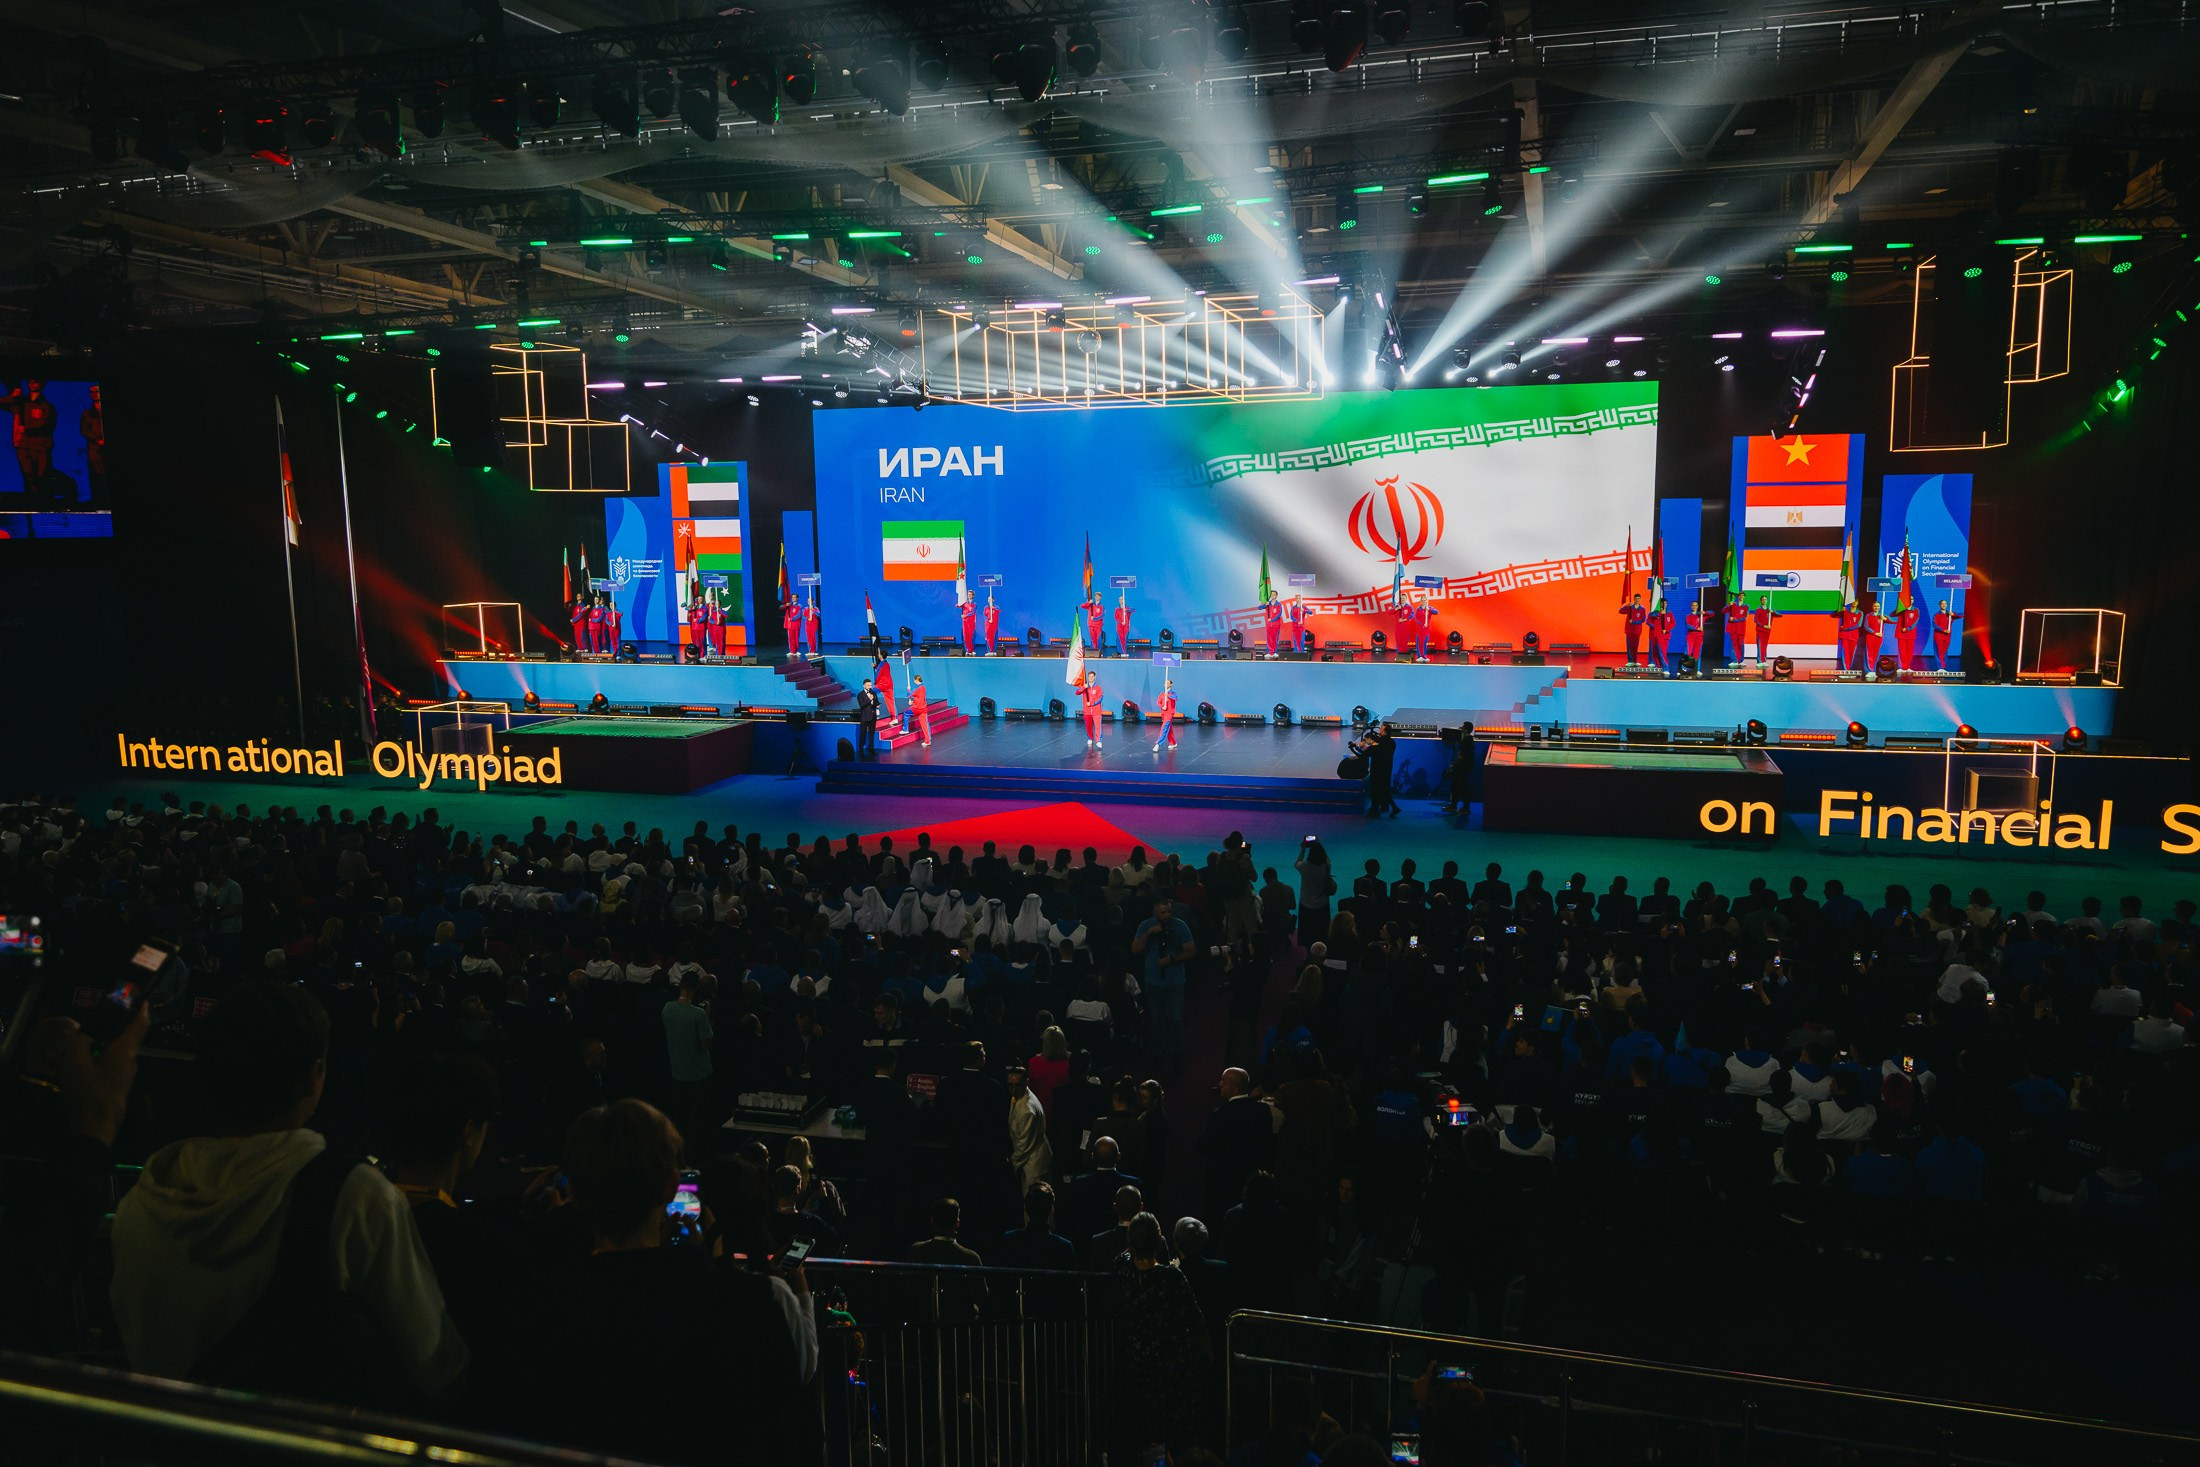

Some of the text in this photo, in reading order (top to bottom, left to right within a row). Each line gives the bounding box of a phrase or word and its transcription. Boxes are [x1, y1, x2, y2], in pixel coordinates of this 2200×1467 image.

[879, 445, 1004, 478] ИРАН
[880, 487, 925, 503] IRAN
[118, 733, 562, 791] International Olympiad
[1700, 788, 2200, 854] on Financial S
